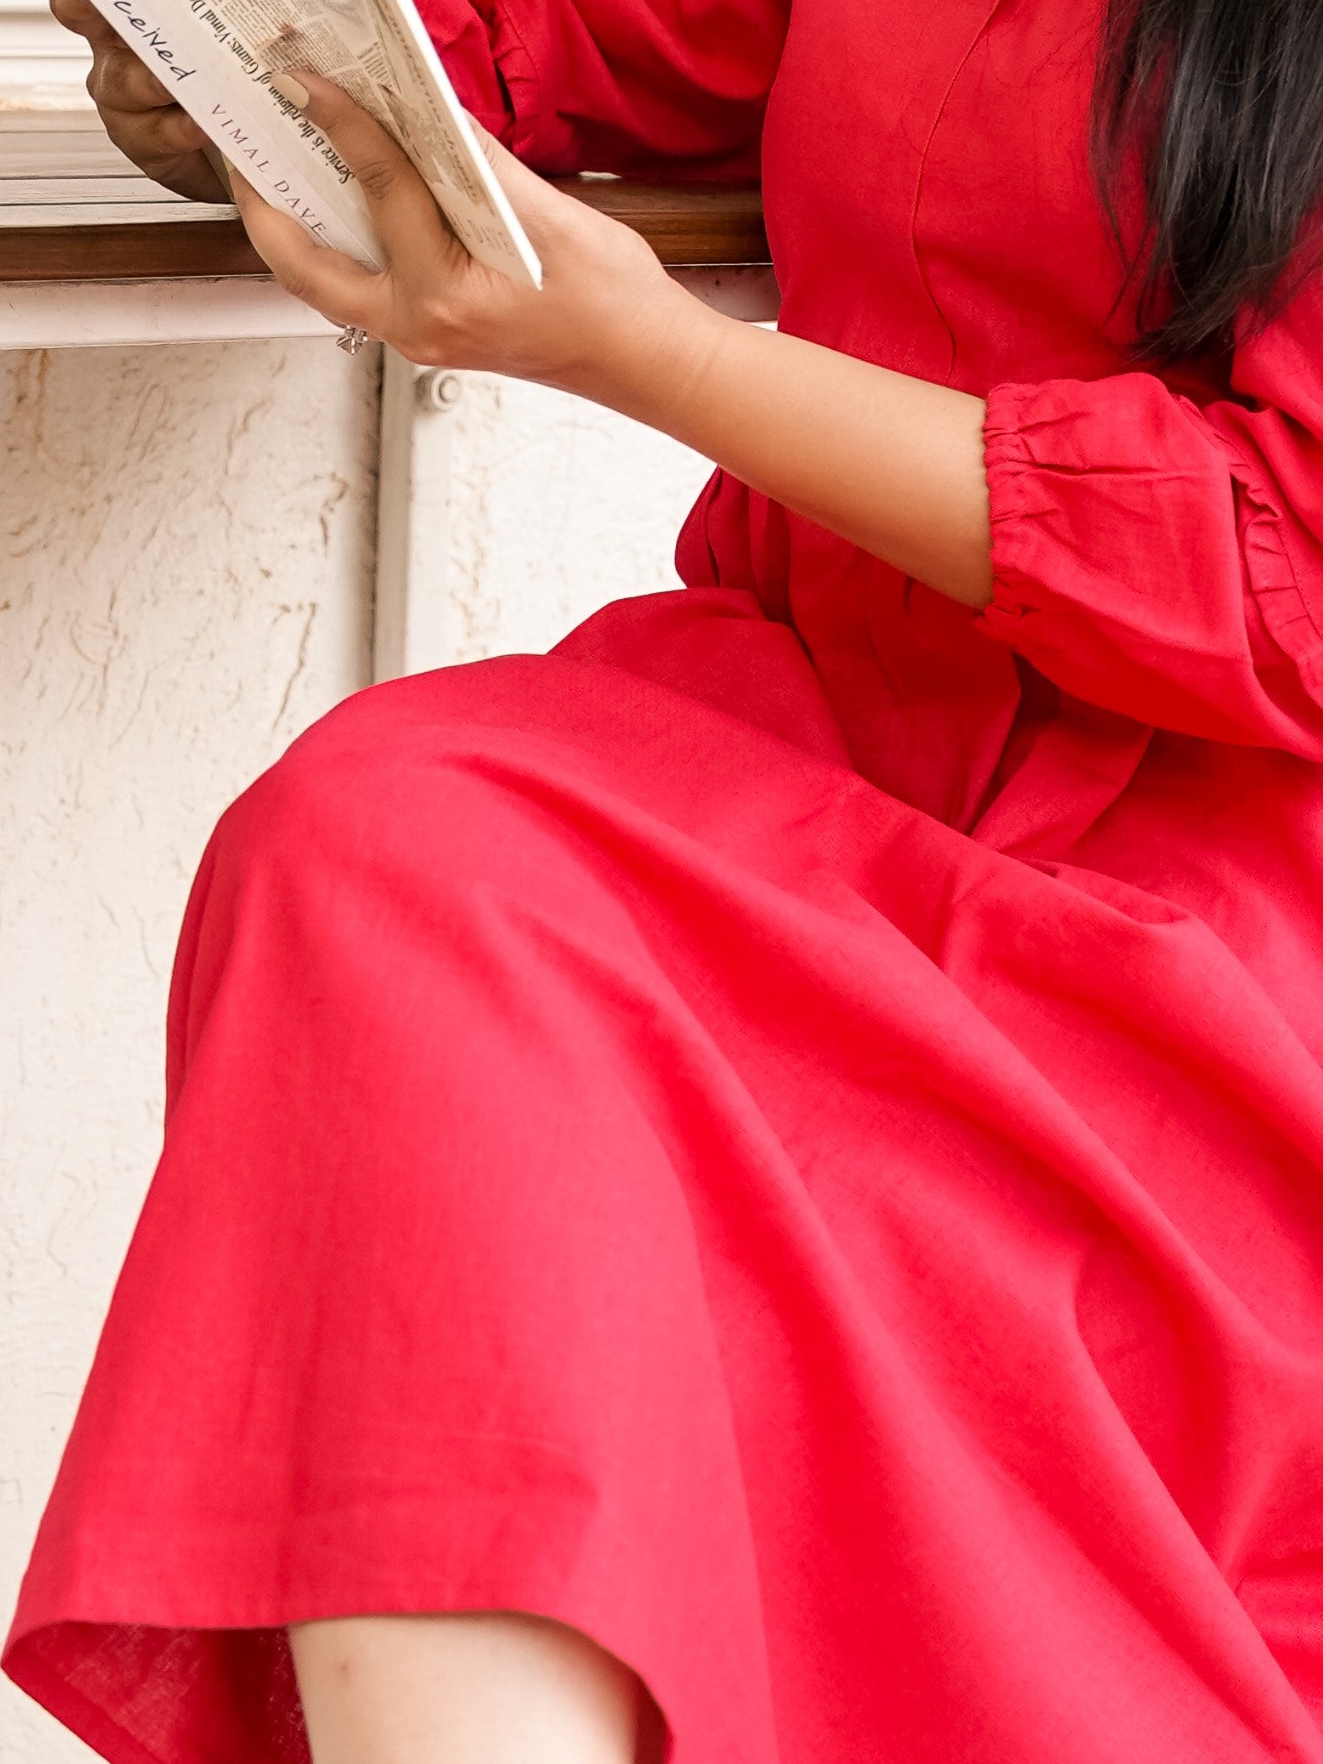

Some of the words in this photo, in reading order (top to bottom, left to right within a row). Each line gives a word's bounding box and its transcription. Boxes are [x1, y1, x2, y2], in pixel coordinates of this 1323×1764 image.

[202, 8, 234, 45] Vimal
[227, 37, 260, 76] Giants:
[252, 71, 273, 86] of
[297, 118, 317, 139] the
[311, 135, 326, 151] is
[211, 103, 269, 173] VIMAL
[274, 179, 326, 237] DAVE
[321, 144, 356, 185] Service
